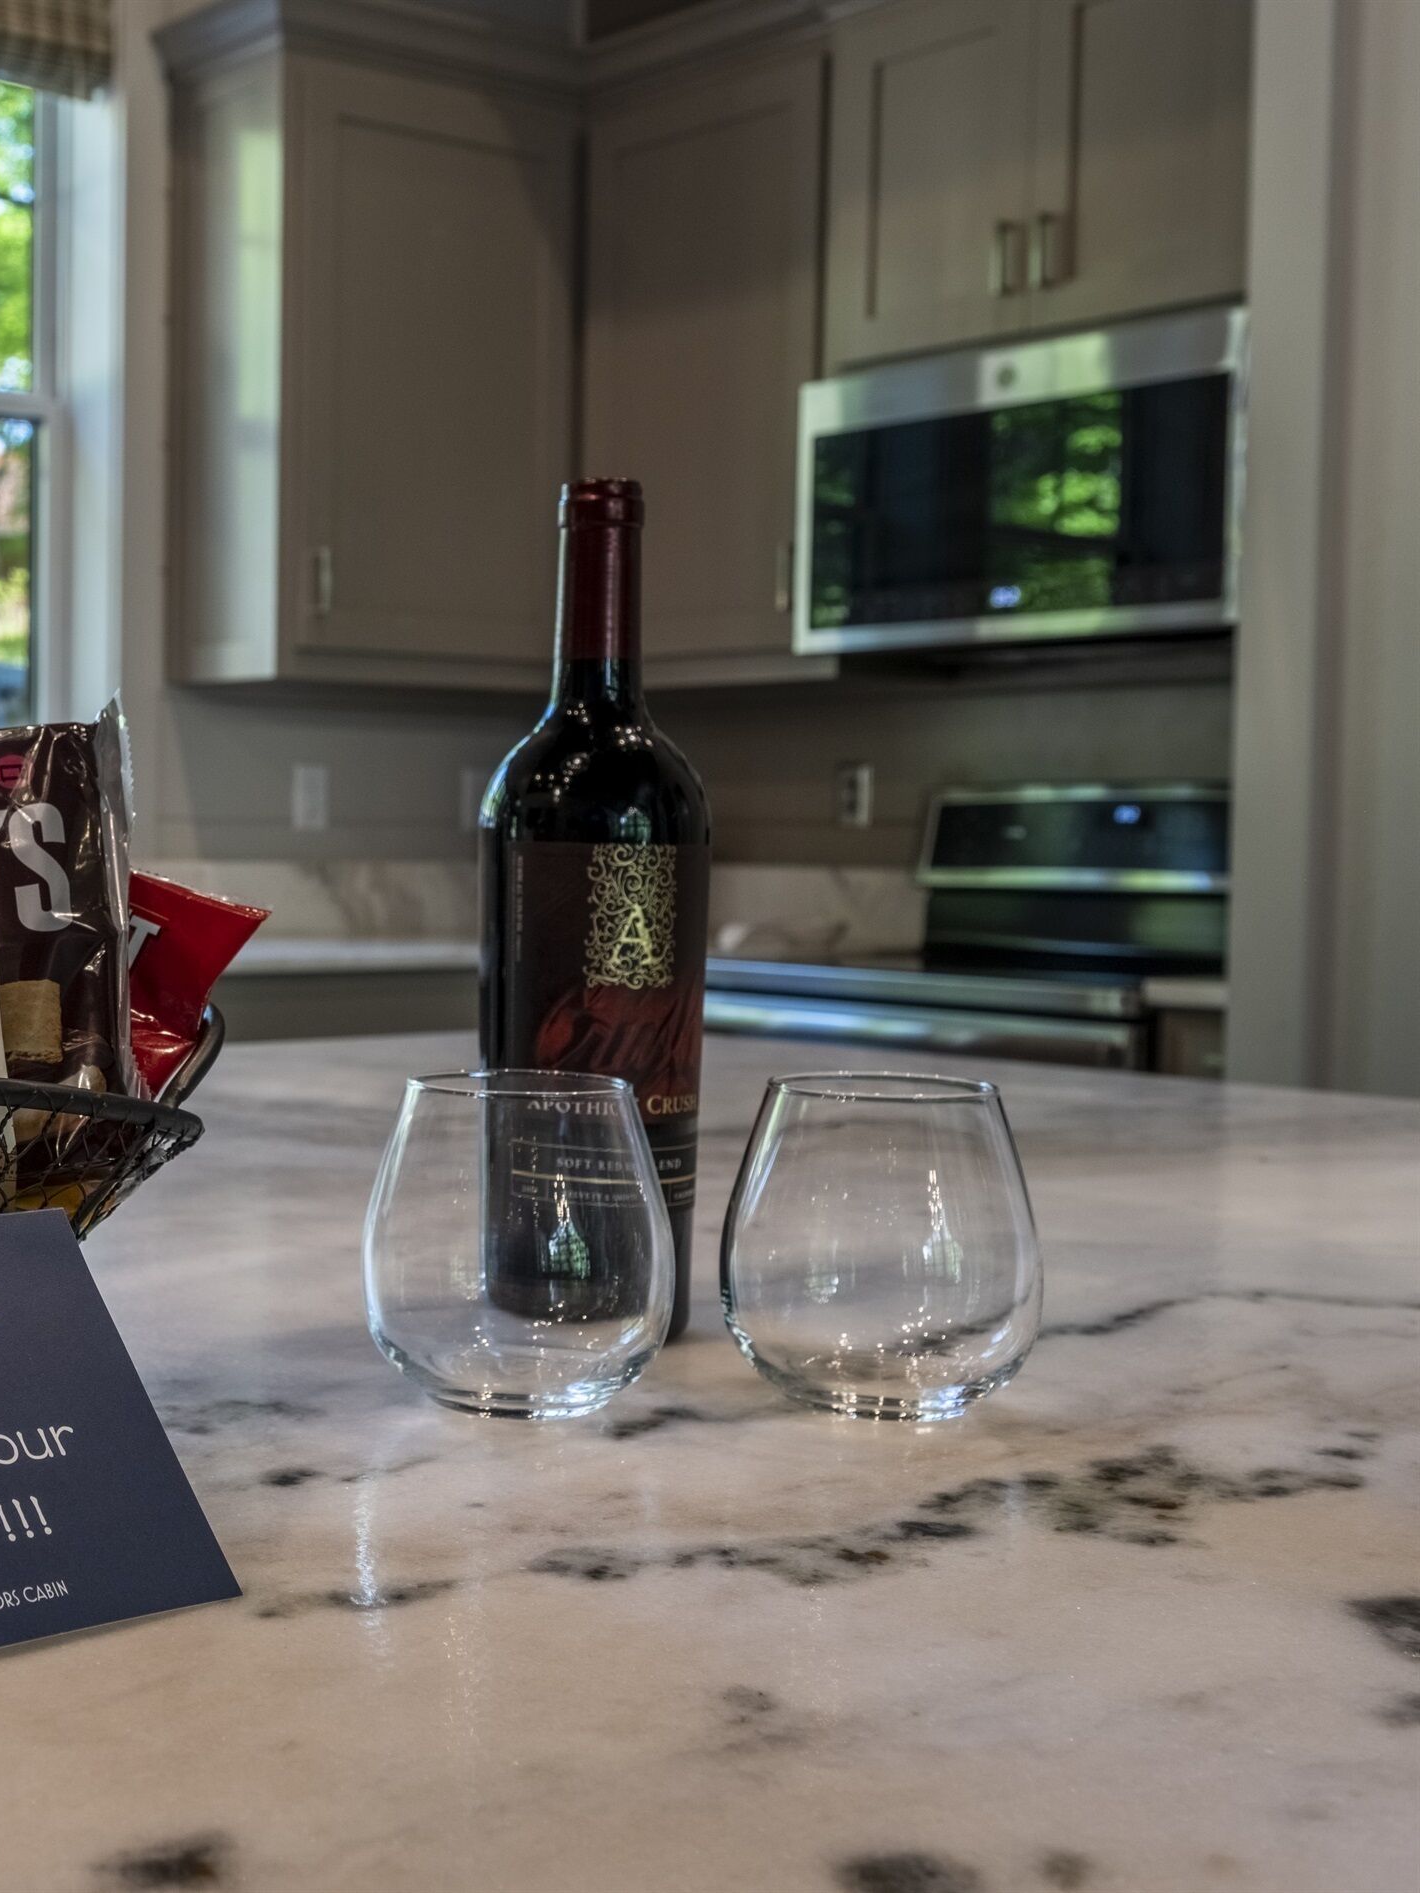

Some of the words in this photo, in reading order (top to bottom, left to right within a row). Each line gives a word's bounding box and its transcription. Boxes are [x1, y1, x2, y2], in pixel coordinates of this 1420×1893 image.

[613, 903, 657, 965] A
[646, 1094, 697, 1115] CRUSH
[556, 1157, 591, 1170] SOFT
[23, 1580, 69, 1603] CABIN
